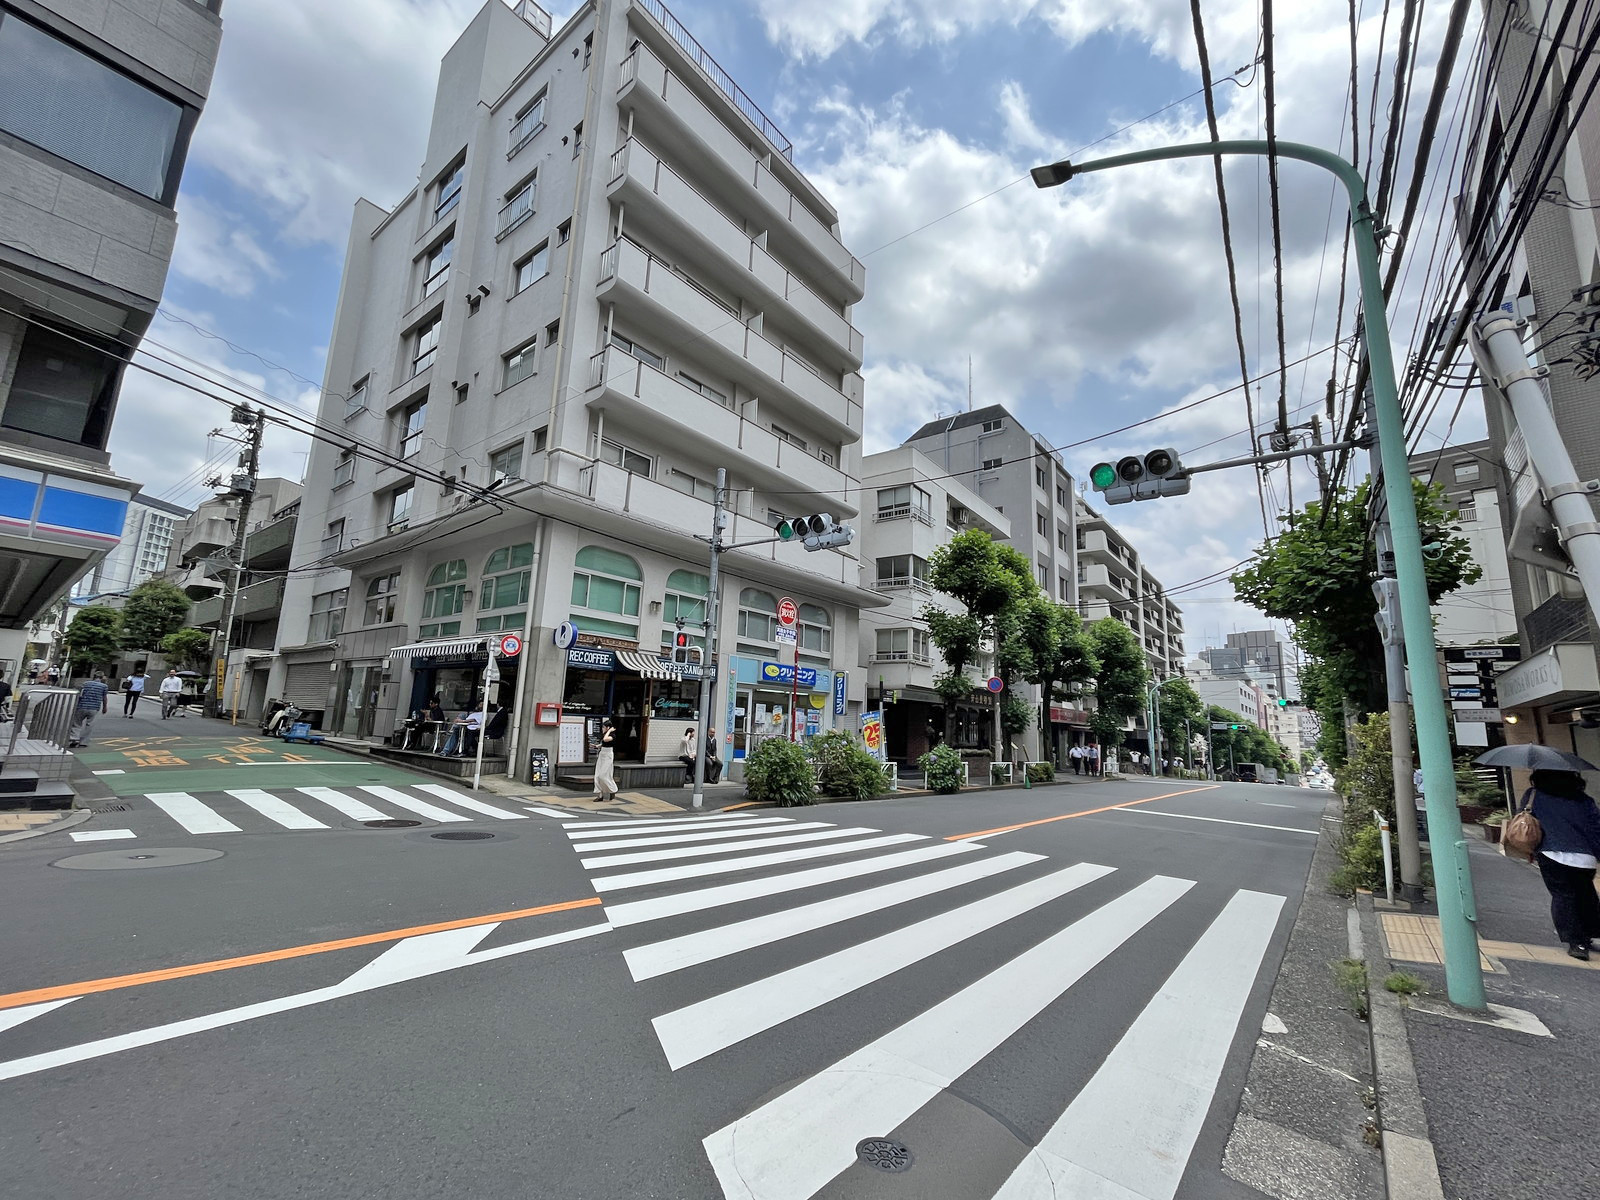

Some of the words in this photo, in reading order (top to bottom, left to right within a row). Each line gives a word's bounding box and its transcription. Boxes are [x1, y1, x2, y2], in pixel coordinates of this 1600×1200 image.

[569, 649, 584, 662] REC
[836, 677, 844, 714] クリーニング
